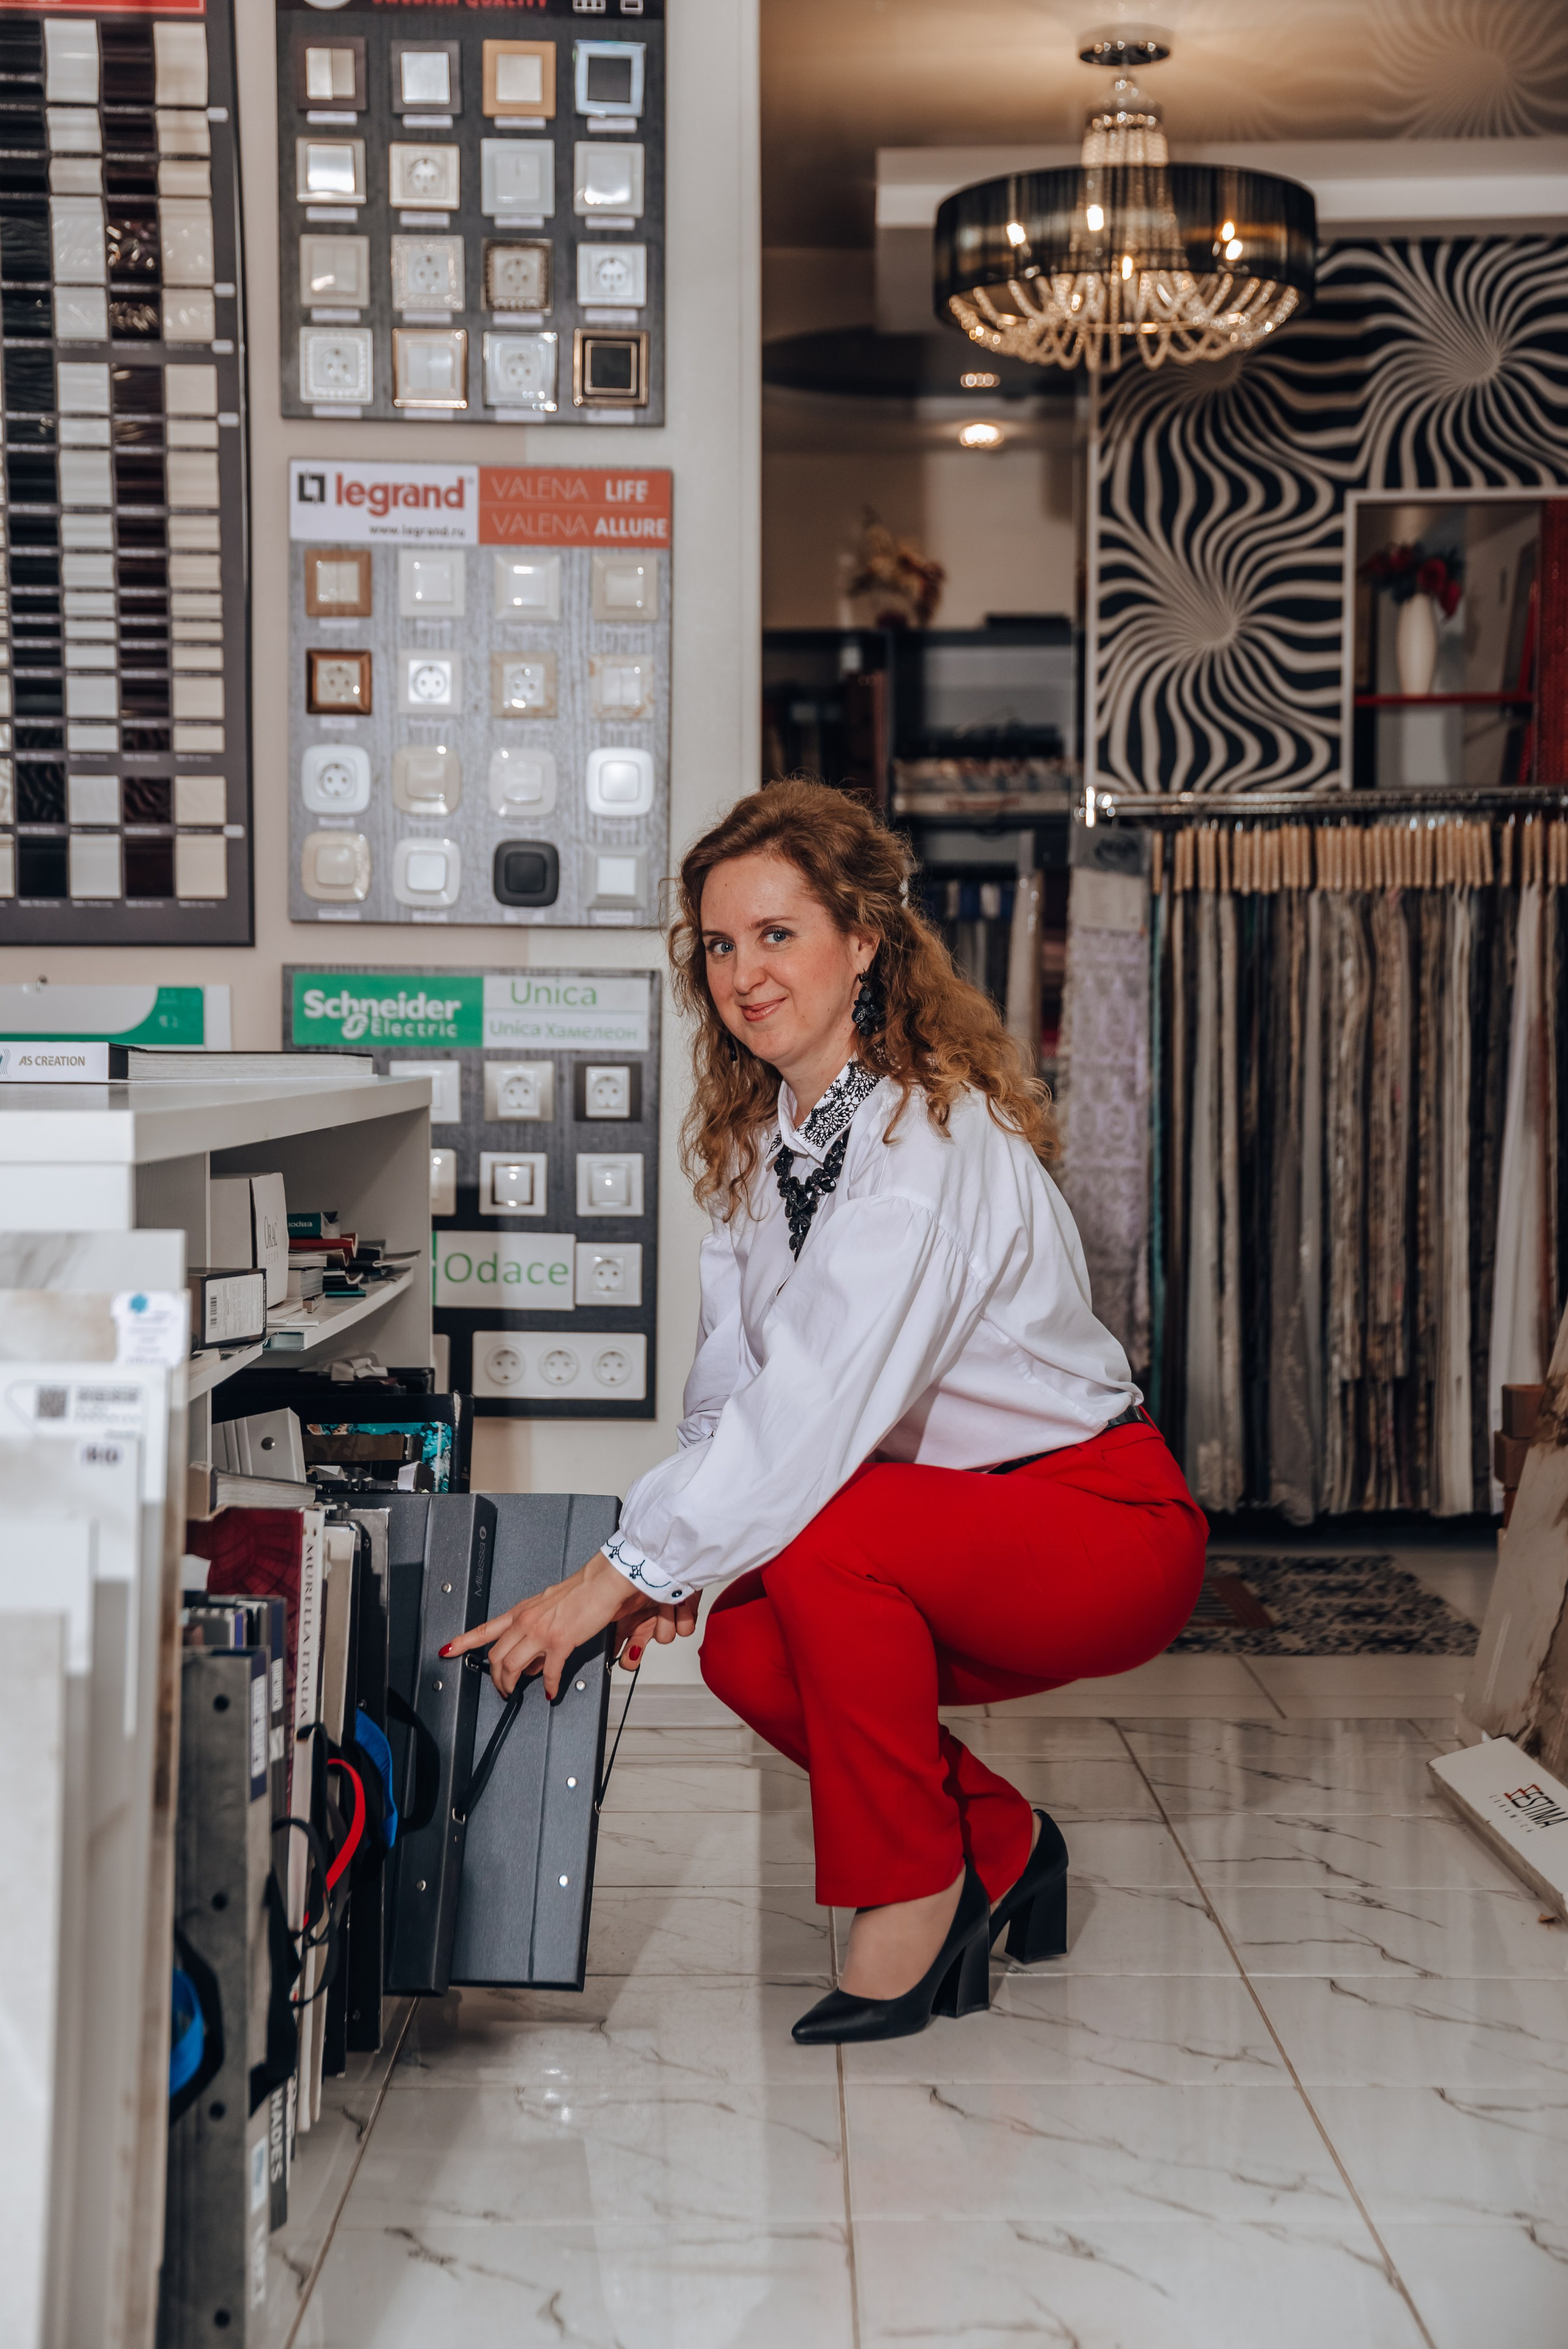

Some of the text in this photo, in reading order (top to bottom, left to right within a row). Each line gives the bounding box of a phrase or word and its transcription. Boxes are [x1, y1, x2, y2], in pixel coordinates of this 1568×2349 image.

[336, 472, 465, 518] legrand
[491, 475, 649, 502] VALENA LIFE
[369, 524, 466, 538] www.legrand.ru
[491, 513, 668, 538] VALENA ALLURE
[303, 989, 462, 1021] Schneider
[511, 978, 597, 1006] Unica
[371, 1018, 458, 1038] Electric
[490, 1020, 638, 1040] Unica Хамелеон
[18, 1055, 85, 1066] AS CREATION
[444, 1251, 568, 1285] Odace
[475, 1542, 486, 1597] Milassa
[300, 1542, 314, 1719] MURELLA ITALIA
